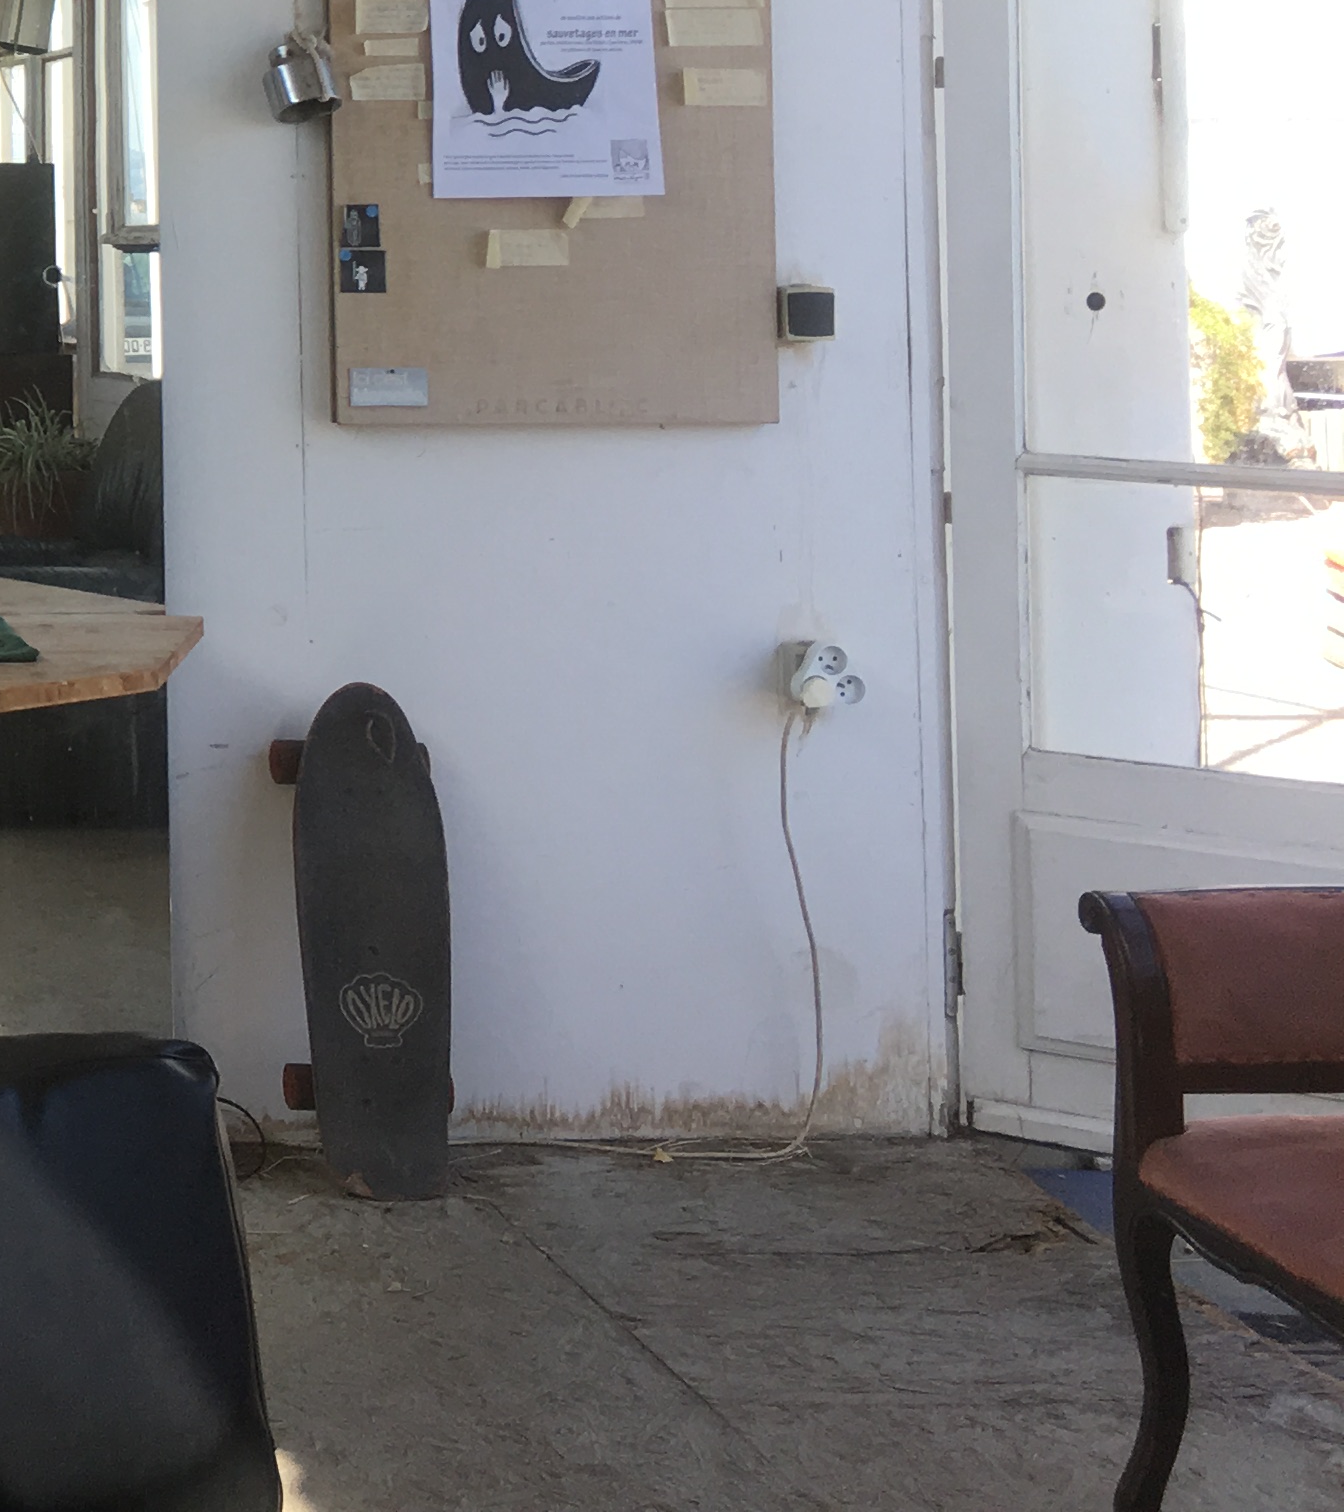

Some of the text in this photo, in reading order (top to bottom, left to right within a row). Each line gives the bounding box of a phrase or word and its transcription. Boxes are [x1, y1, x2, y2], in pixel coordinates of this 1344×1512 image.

[547, 29, 639, 40] sauvetages en mer
[345, 983, 415, 1032] OXELO
